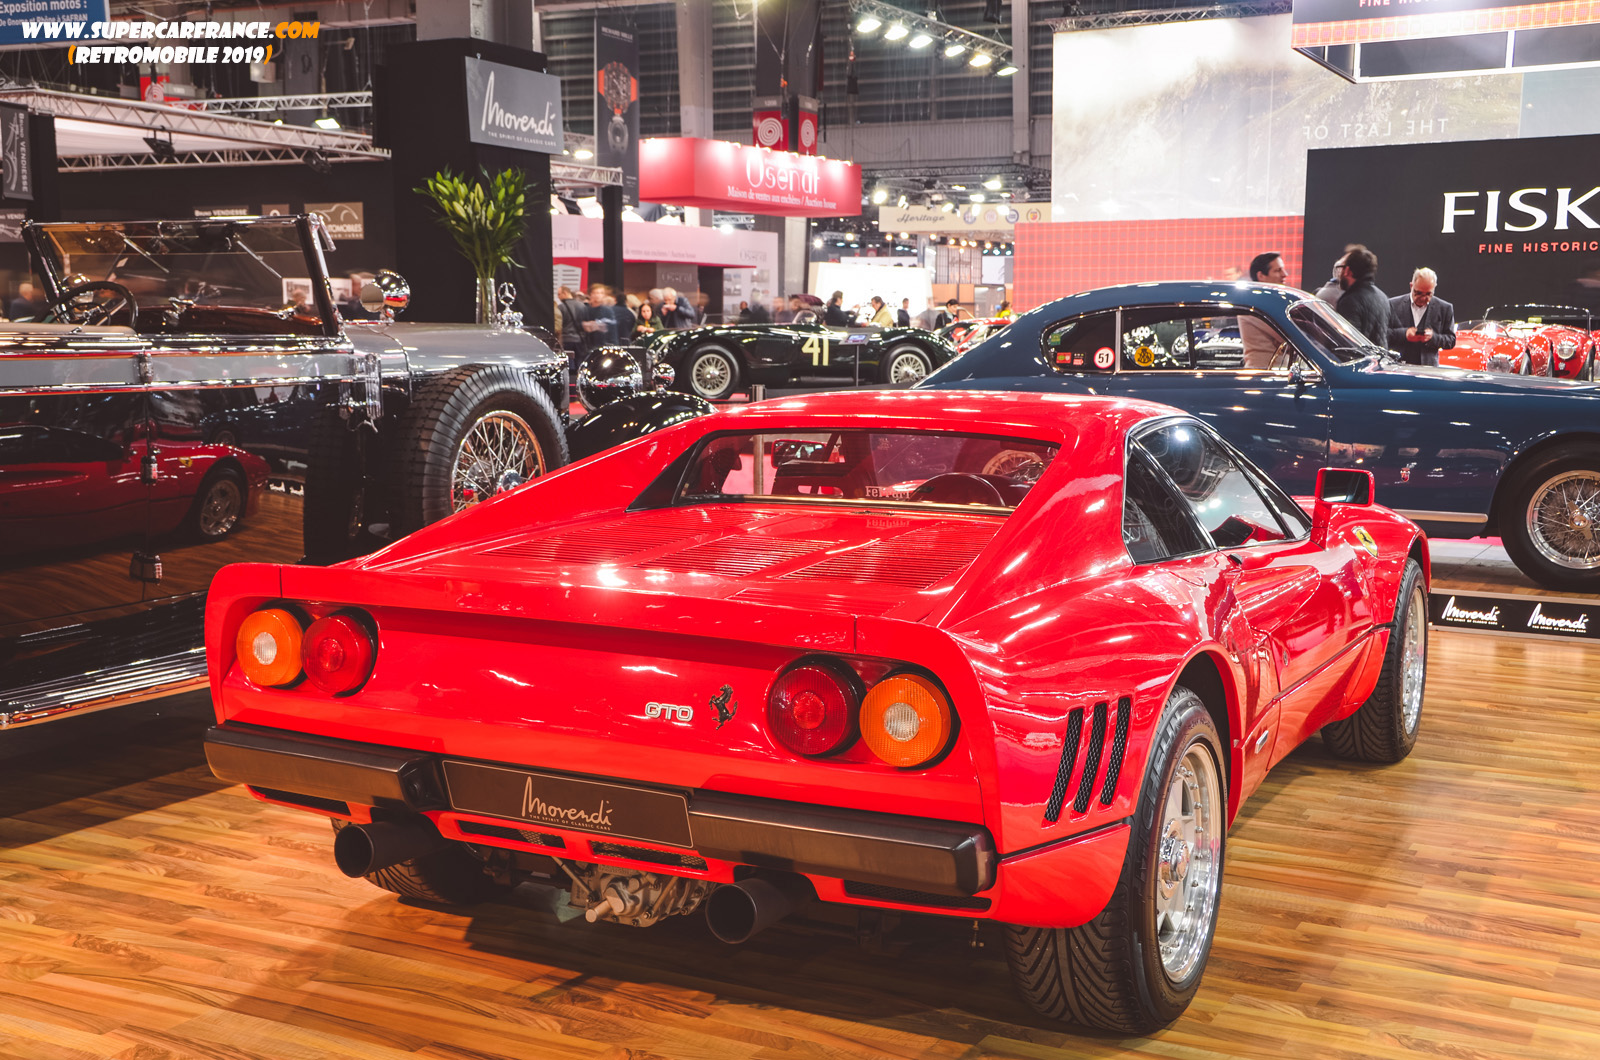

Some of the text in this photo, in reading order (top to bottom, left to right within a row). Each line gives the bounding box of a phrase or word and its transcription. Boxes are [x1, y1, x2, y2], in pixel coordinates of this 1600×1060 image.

[50, 0, 81, 10] motos
[481, 70, 556, 137] Movendi
[728, 185, 748, 199] Maison
[748, 188, 755, 199] de
[755, 192, 771, 201] ventes
[771, 194, 780, 203] aux
[804, 196, 823, 208] Auction
[823, 198, 837, 209] house
[896, 213, 945, 223] Heritage
[1441, 186, 1600, 234] FISK
[1478, 240, 1599, 254] FINE HISTORIC
[801, 333, 830, 366] 41
[1098, 353, 1110, 364] 51
[865, 485, 910, 499] Ferrari
[1441, 596, 1500, 621] Movendi
[1527, 602, 1589, 629] Movendi
[645, 702, 693, 722] GTO
[521, 775, 613, 826] Movendi
[571, 821, 594, 829] CLASSIC
